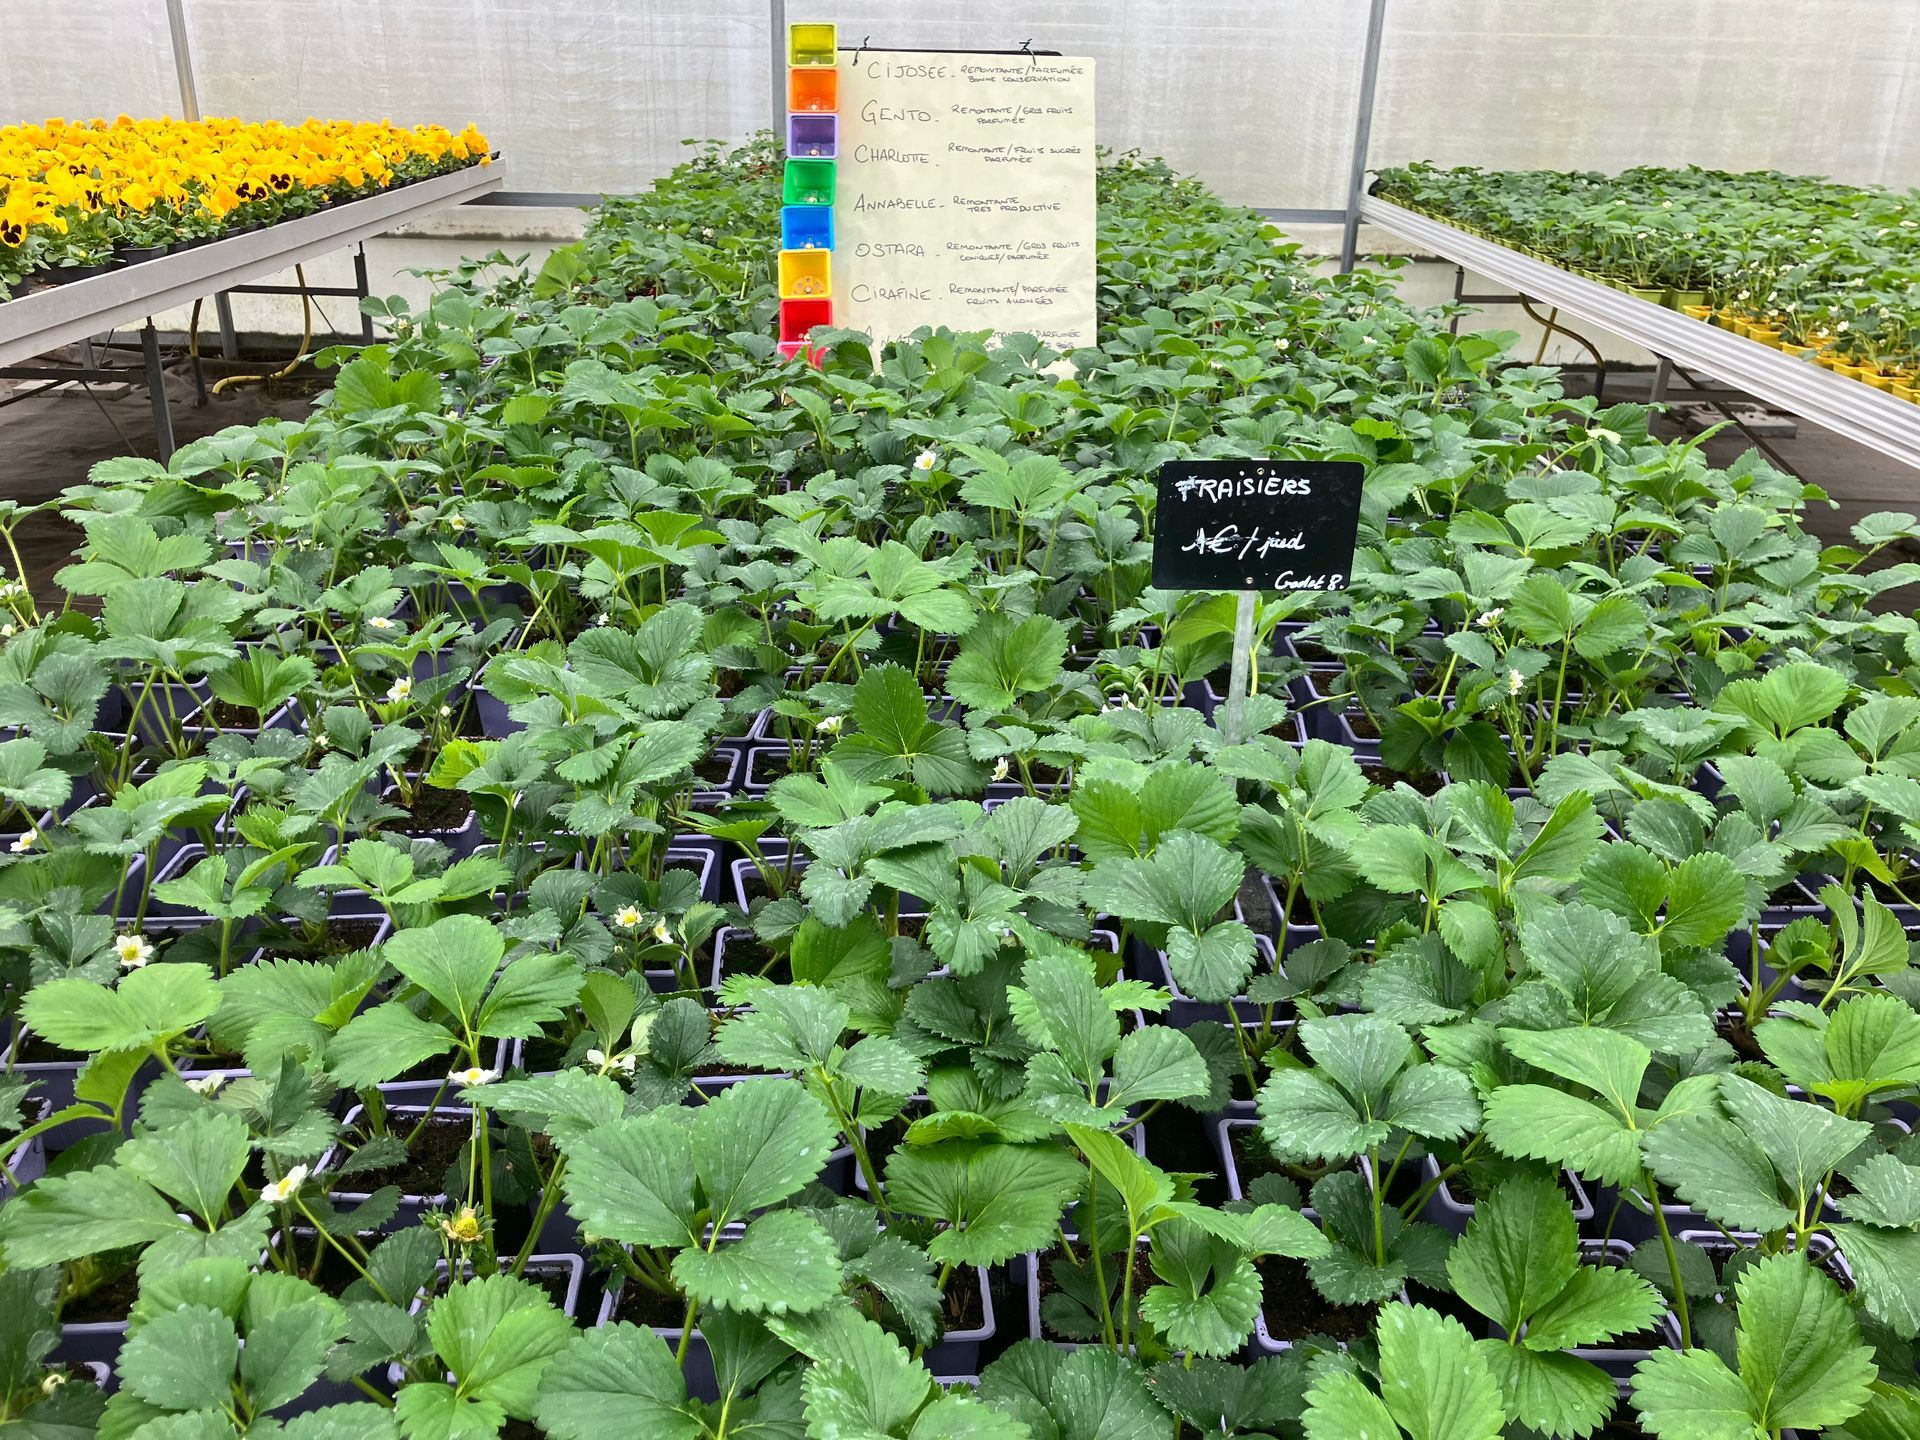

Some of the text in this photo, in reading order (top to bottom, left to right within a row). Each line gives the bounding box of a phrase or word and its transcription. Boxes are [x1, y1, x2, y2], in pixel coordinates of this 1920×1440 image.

[1002, 75, 1071, 83] CONSERVATION
[854, 144, 931, 165] CHARLOTTE
[853, 193, 936, 213] ANNABELLE
[953, 195, 1019, 206] REMONTANTE
[1000, 203, 1061, 212] PRODUCTIVE
[855, 243, 925, 258] OSTARA
